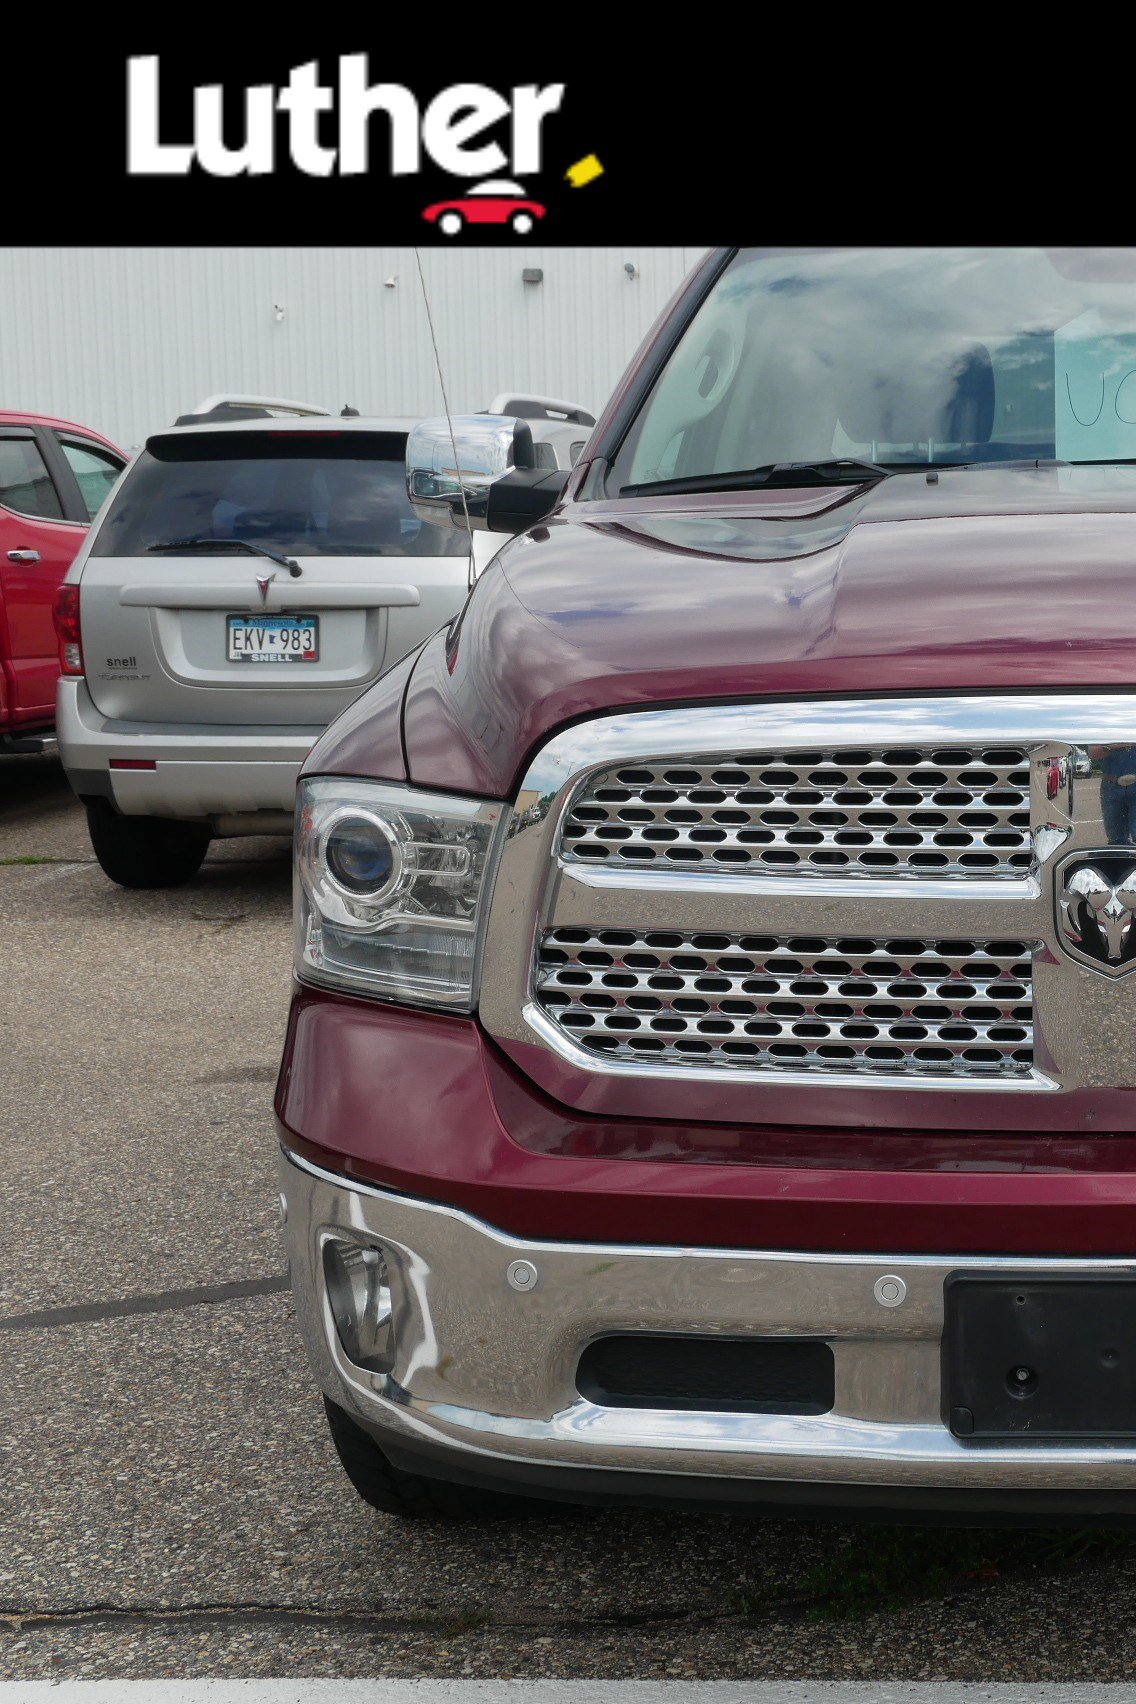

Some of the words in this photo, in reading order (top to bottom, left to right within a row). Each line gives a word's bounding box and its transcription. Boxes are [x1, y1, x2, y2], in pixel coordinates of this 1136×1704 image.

[232, 628, 266, 651] EKV
[280, 628, 312, 651] 983
[106, 656, 137, 667] snell
[250, 653, 293, 662] SNELL
